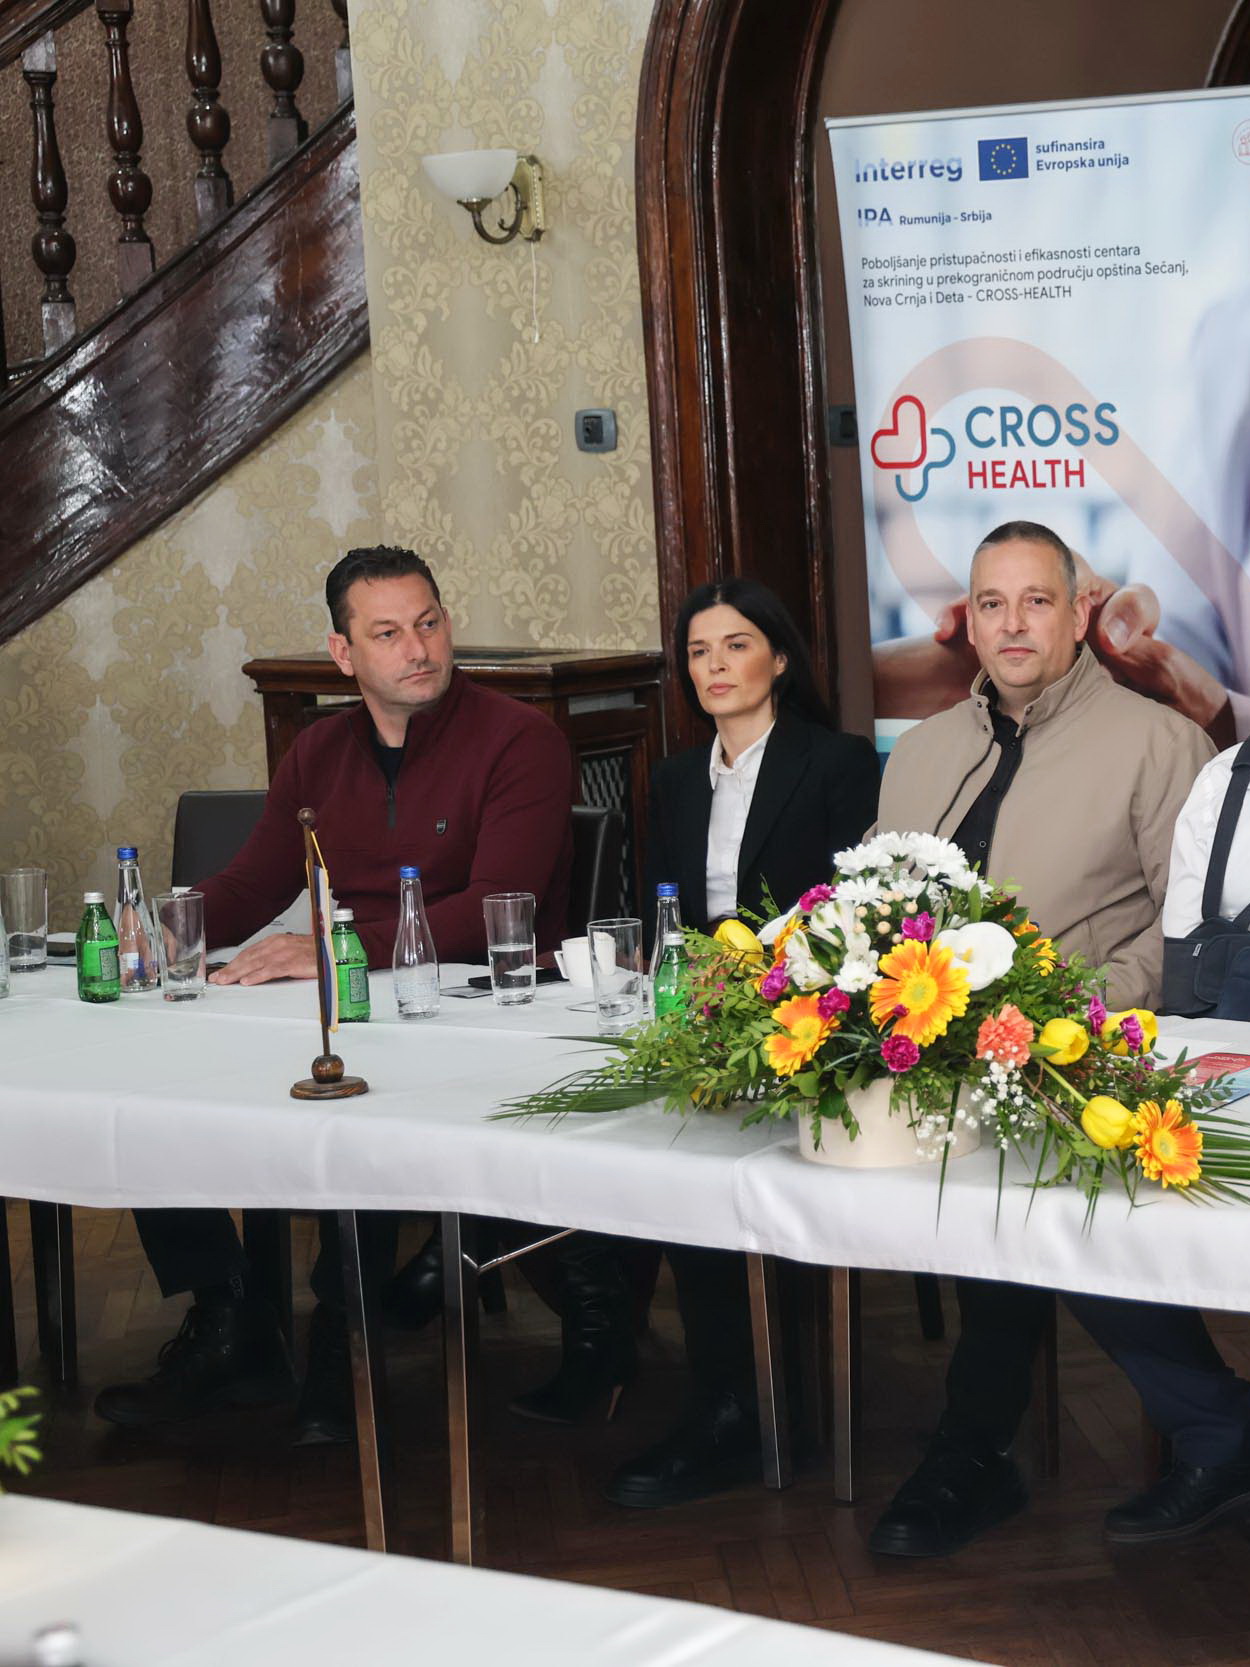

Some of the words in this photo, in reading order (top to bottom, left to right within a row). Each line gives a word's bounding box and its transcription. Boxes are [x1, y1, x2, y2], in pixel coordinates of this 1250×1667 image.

[1036, 138, 1105, 153] sufinansira
[855, 157, 963, 182] Interreg
[1036, 157, 1095, 173] Evropska
[1098, 154, 1130, 169] unija
[899, 211, 951, 226] Rumunija
[960, 209, 993, 224] Srbija
[861, 253, 927, 271] Poboljšanje
[930, 249, 1017, 270] pristupačnosti
[1024, 246, 1092, 262] efikasnosti
[1094, 245, 1141, 258] centara
[862, 278, 875, 288] za
[877, 273, 923, 289] skrining
[926, 277, 934, 286] u
[936, 269, 1034, 288] prekograničnom
[1096, 263, 1142, 280] opština
[863, 294, 892, 307] Nova
[895, 292, 927, 308] Crnja
[935, 291, 964, 304] Deta
[976, 285, 1072, 302] CROSS-HEALTH
[965, 402, 1120, 448] CROSS
[967, 459, 1086, 489] HEALTH
